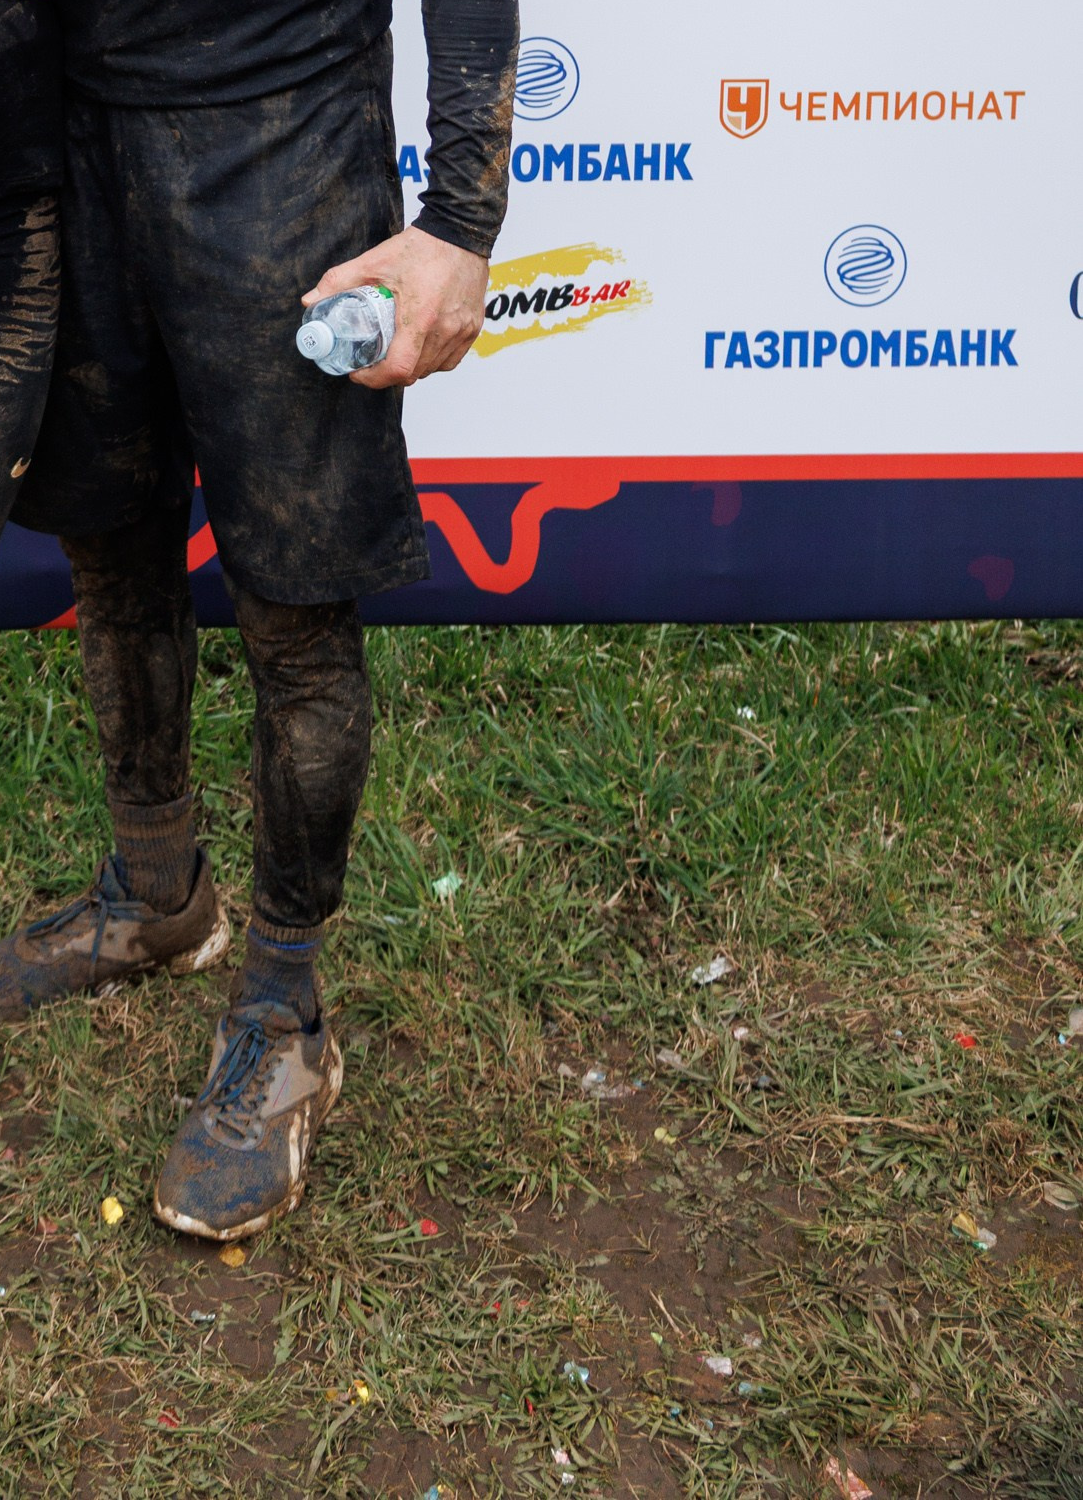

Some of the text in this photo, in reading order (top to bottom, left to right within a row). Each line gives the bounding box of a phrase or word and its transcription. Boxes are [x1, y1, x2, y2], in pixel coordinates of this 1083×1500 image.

[779, 90, 1027, 122] ЧЕМПИОНАТ
[398, 143, 694, 182] АОМБАНК
[485, 280, 631, 322] OMBBAR
[704, 328, 1019, 370] ГАЗПРОМБАНК
